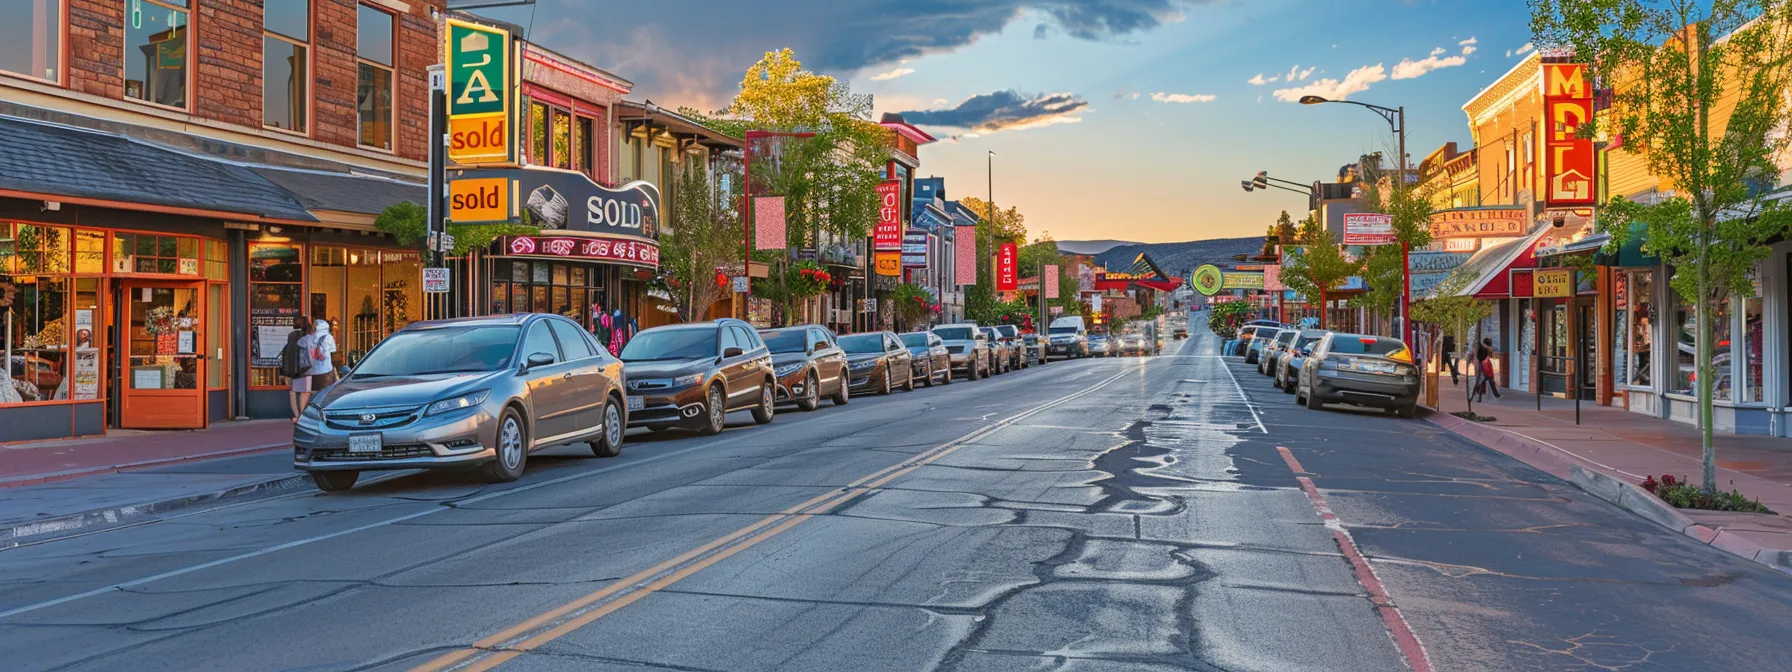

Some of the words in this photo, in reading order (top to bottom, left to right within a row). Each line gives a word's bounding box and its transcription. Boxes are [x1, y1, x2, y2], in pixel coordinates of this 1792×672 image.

[452, 120, 504, 150] sold
[452, 185, 499, 210] sold
[587, 195, 640, 229] SOLD
